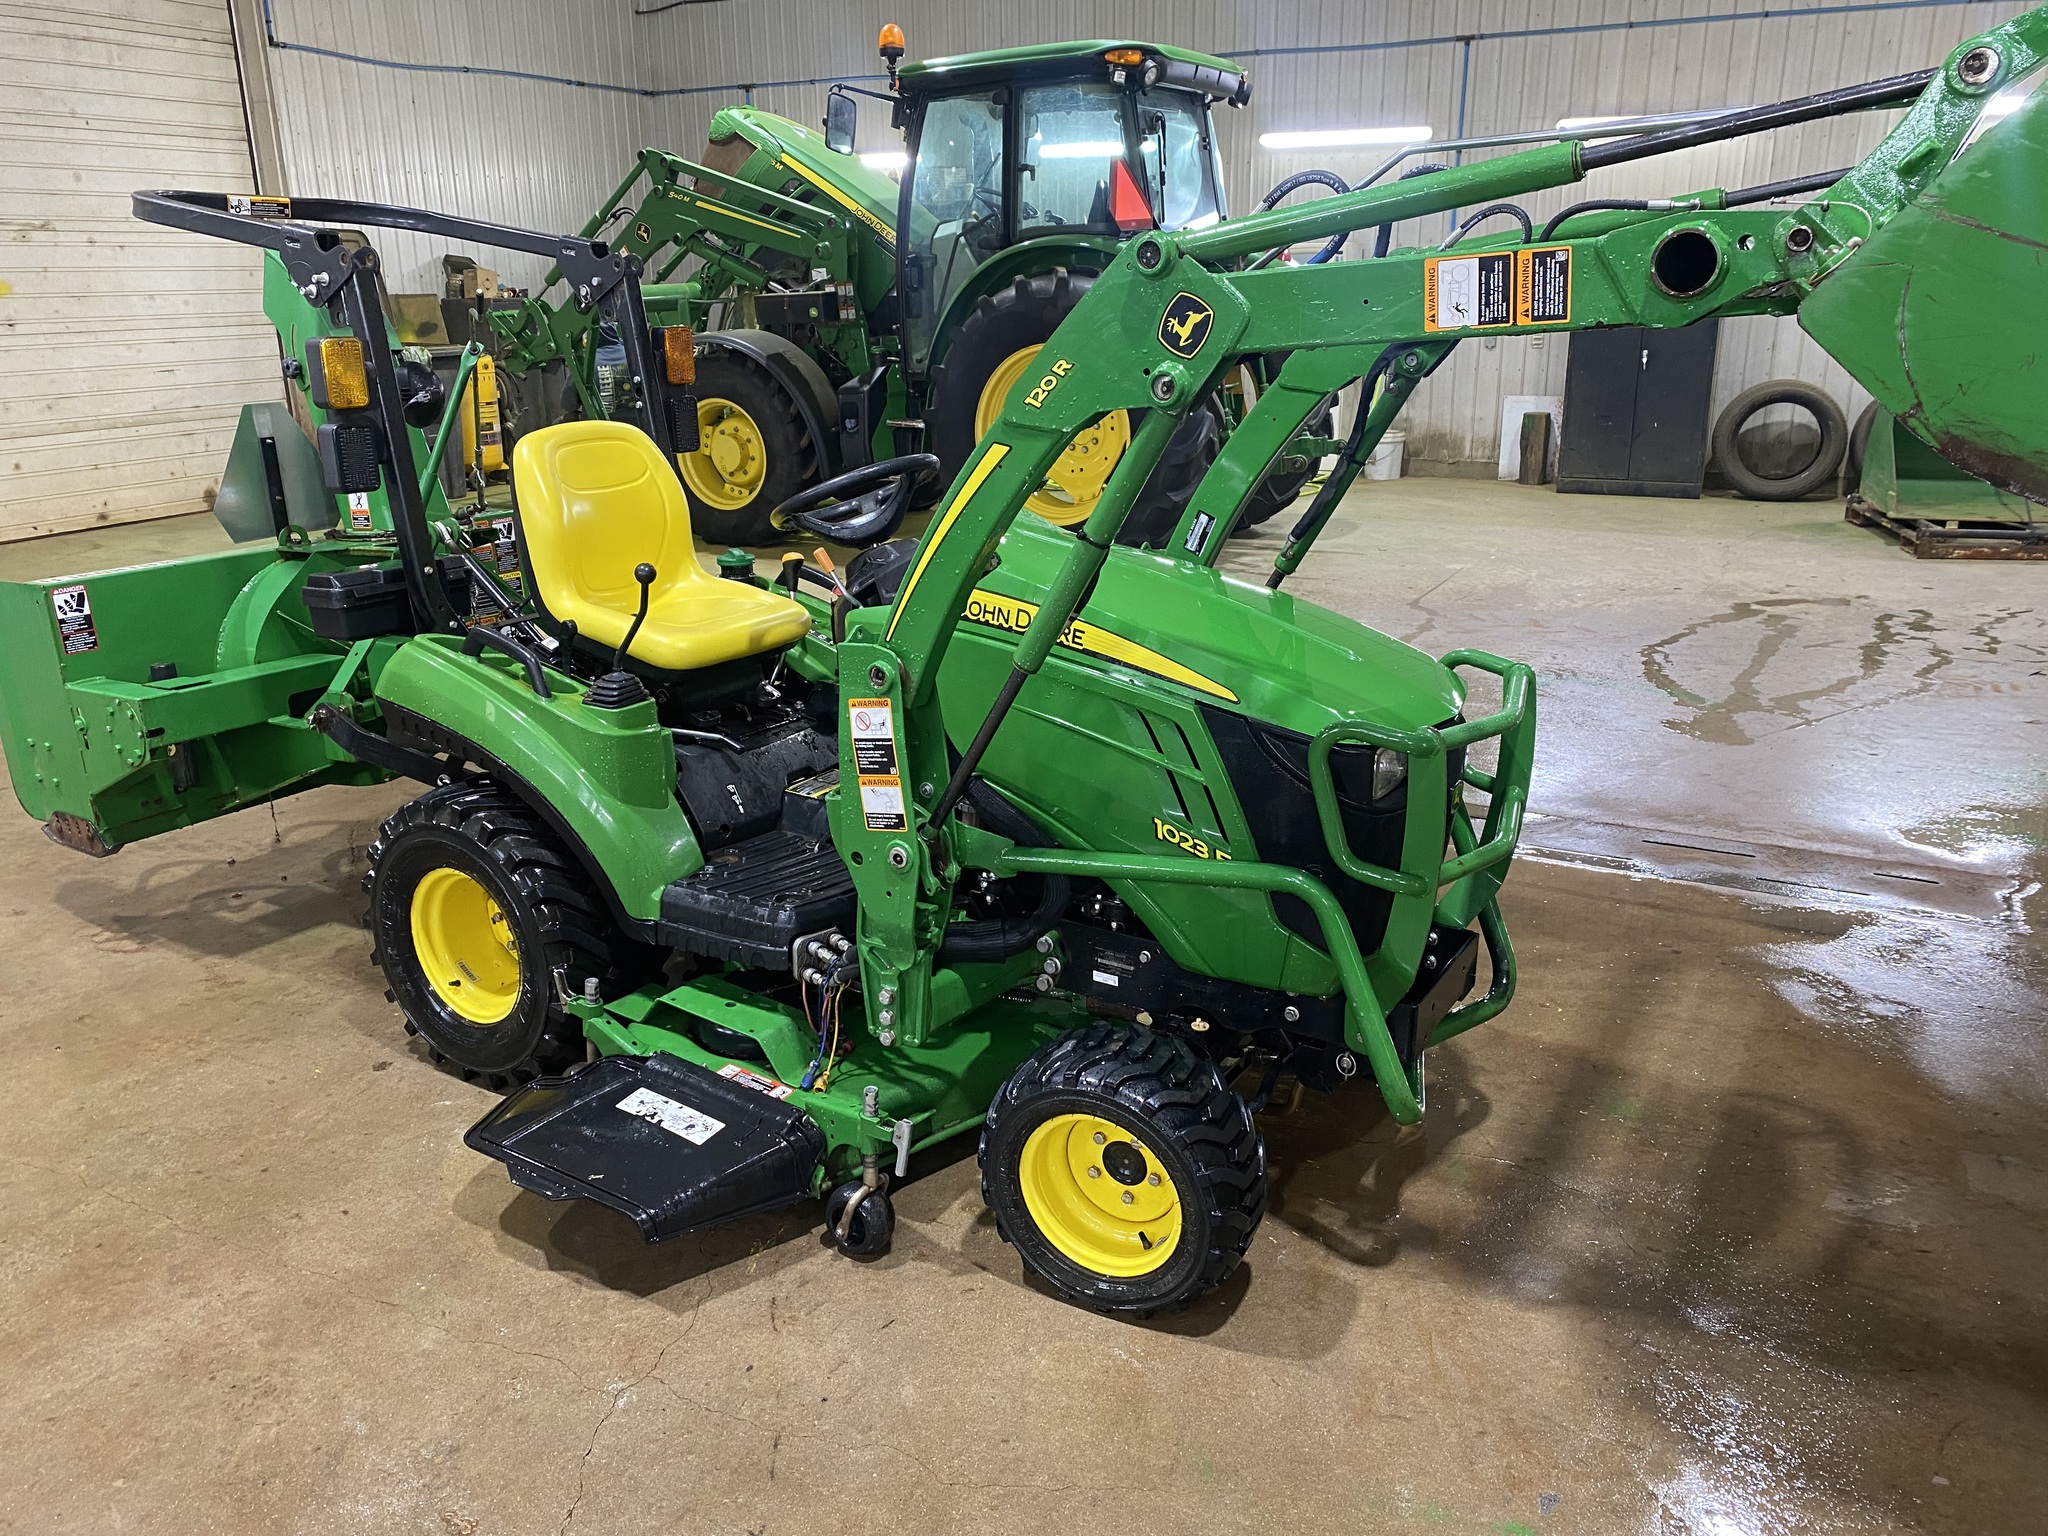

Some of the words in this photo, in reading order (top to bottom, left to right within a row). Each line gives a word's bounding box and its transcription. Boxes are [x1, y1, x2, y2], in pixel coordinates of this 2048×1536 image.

[851, 207, 876, 226] JOHN
[874, 221, 897, 243] DEER
[1428, 267, 1436, 312] WARNING
[60, 585, 85, 593] DANGER
[968, 601, 1011, 626] OHN
[1153, 817, 1209, 859] 1023
